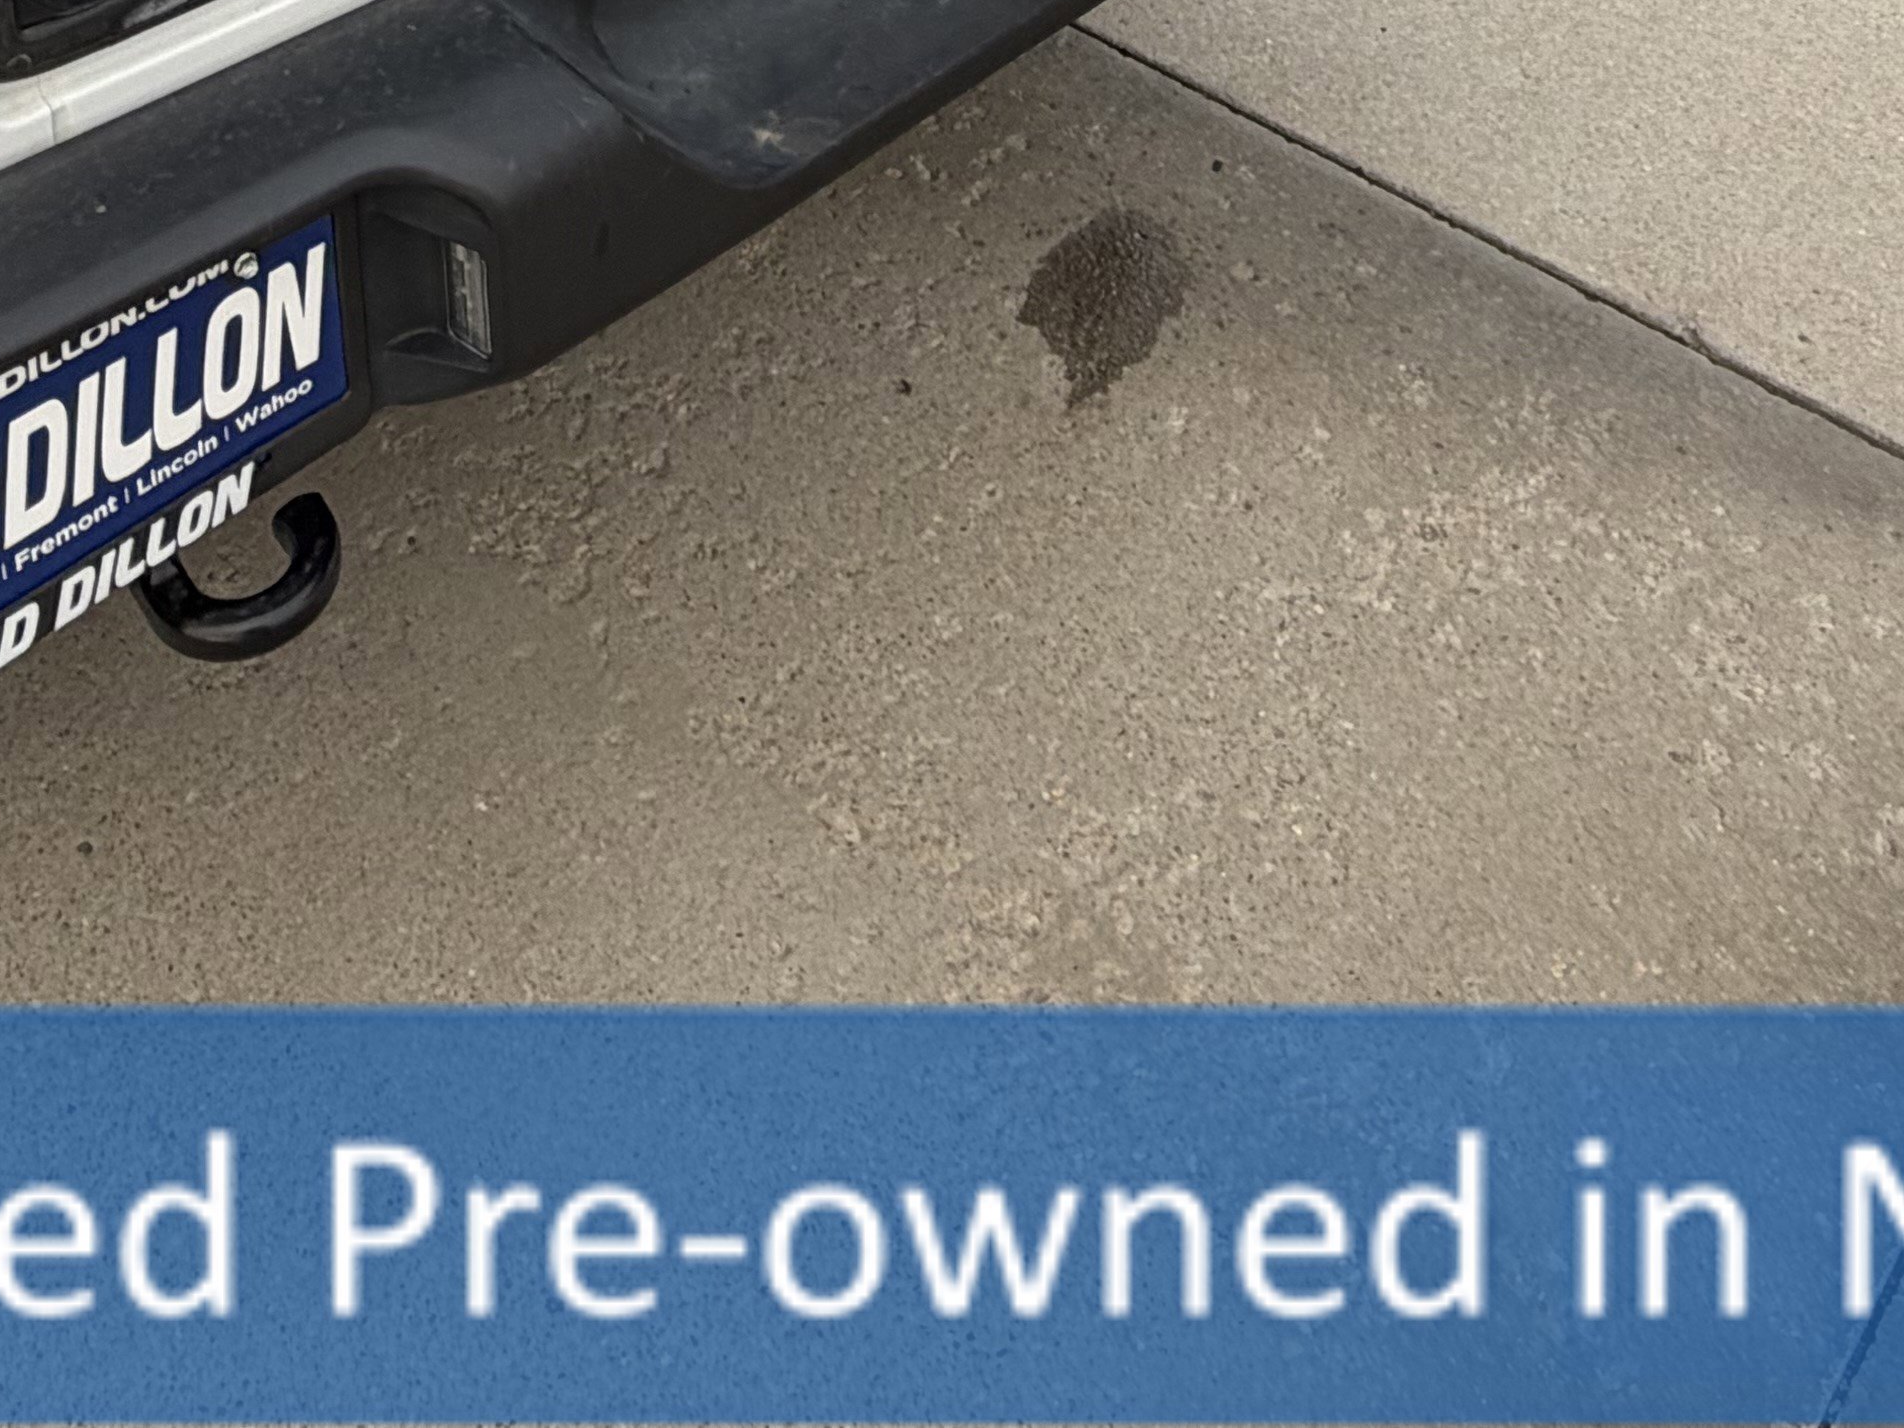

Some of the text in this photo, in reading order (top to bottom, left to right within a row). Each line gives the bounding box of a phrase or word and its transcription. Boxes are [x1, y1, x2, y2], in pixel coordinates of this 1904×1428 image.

[3, 241, 327, 550] DILLON
[14, 493, 119, 572] Fremont
[136, 433, 219, 498] Lincoln
[234, 377, 313, 435] Wahoo
[53, 461, 256, 632] DILLON
